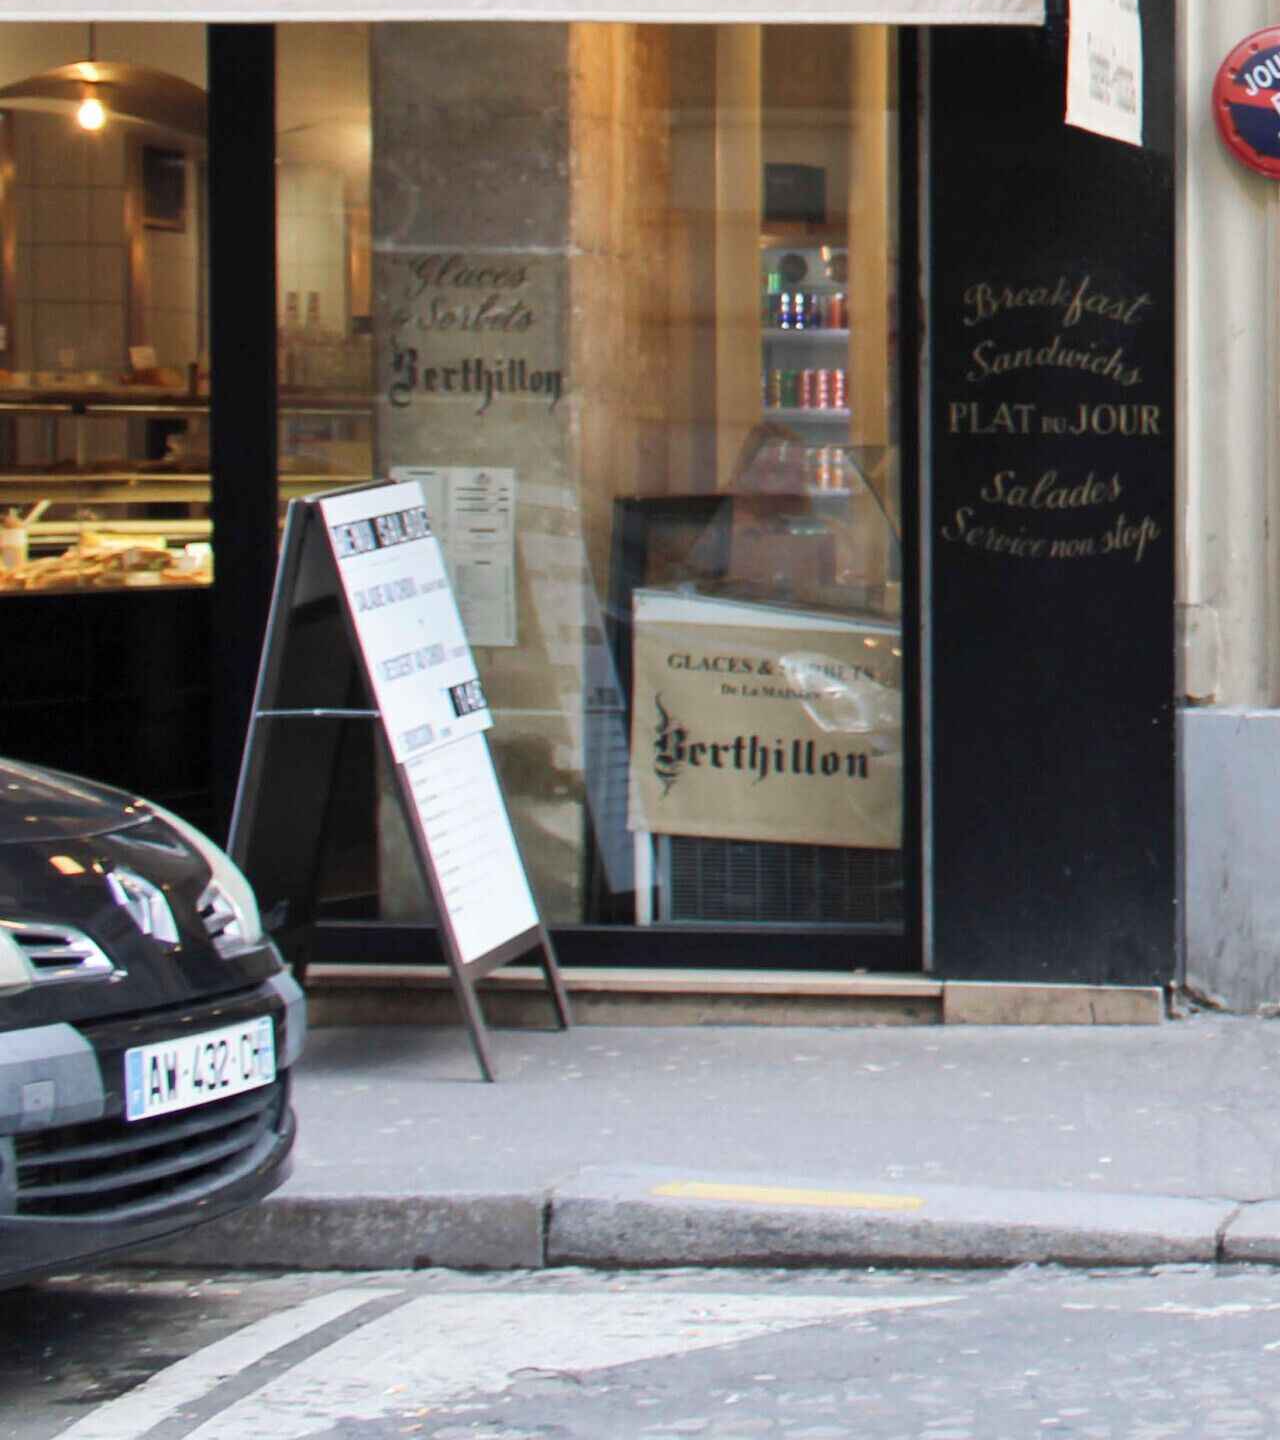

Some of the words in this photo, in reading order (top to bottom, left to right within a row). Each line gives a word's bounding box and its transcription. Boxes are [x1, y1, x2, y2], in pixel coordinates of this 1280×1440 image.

[963, 275, 1150, 327] Breakfast
[388, 335, 562, 415] Berthillon
[966, 336, 1142, 386] Sandwichs
[948, 402, 1036, 434] PLAT
[1041, 416, 1068, 434] DU
[1069, 403, 1160, 435] JOUR
[980, 469, 1122, 509] Salades
[941, 507, 1048, 558] Service
[1049, 535, 1094, 558] non
[1101, 512, 1161, 562] stop
[667, 652, 753, 676] GLACES
[757, 659, 774, 677] &
[653, 690, 870, 796] Berthillon
